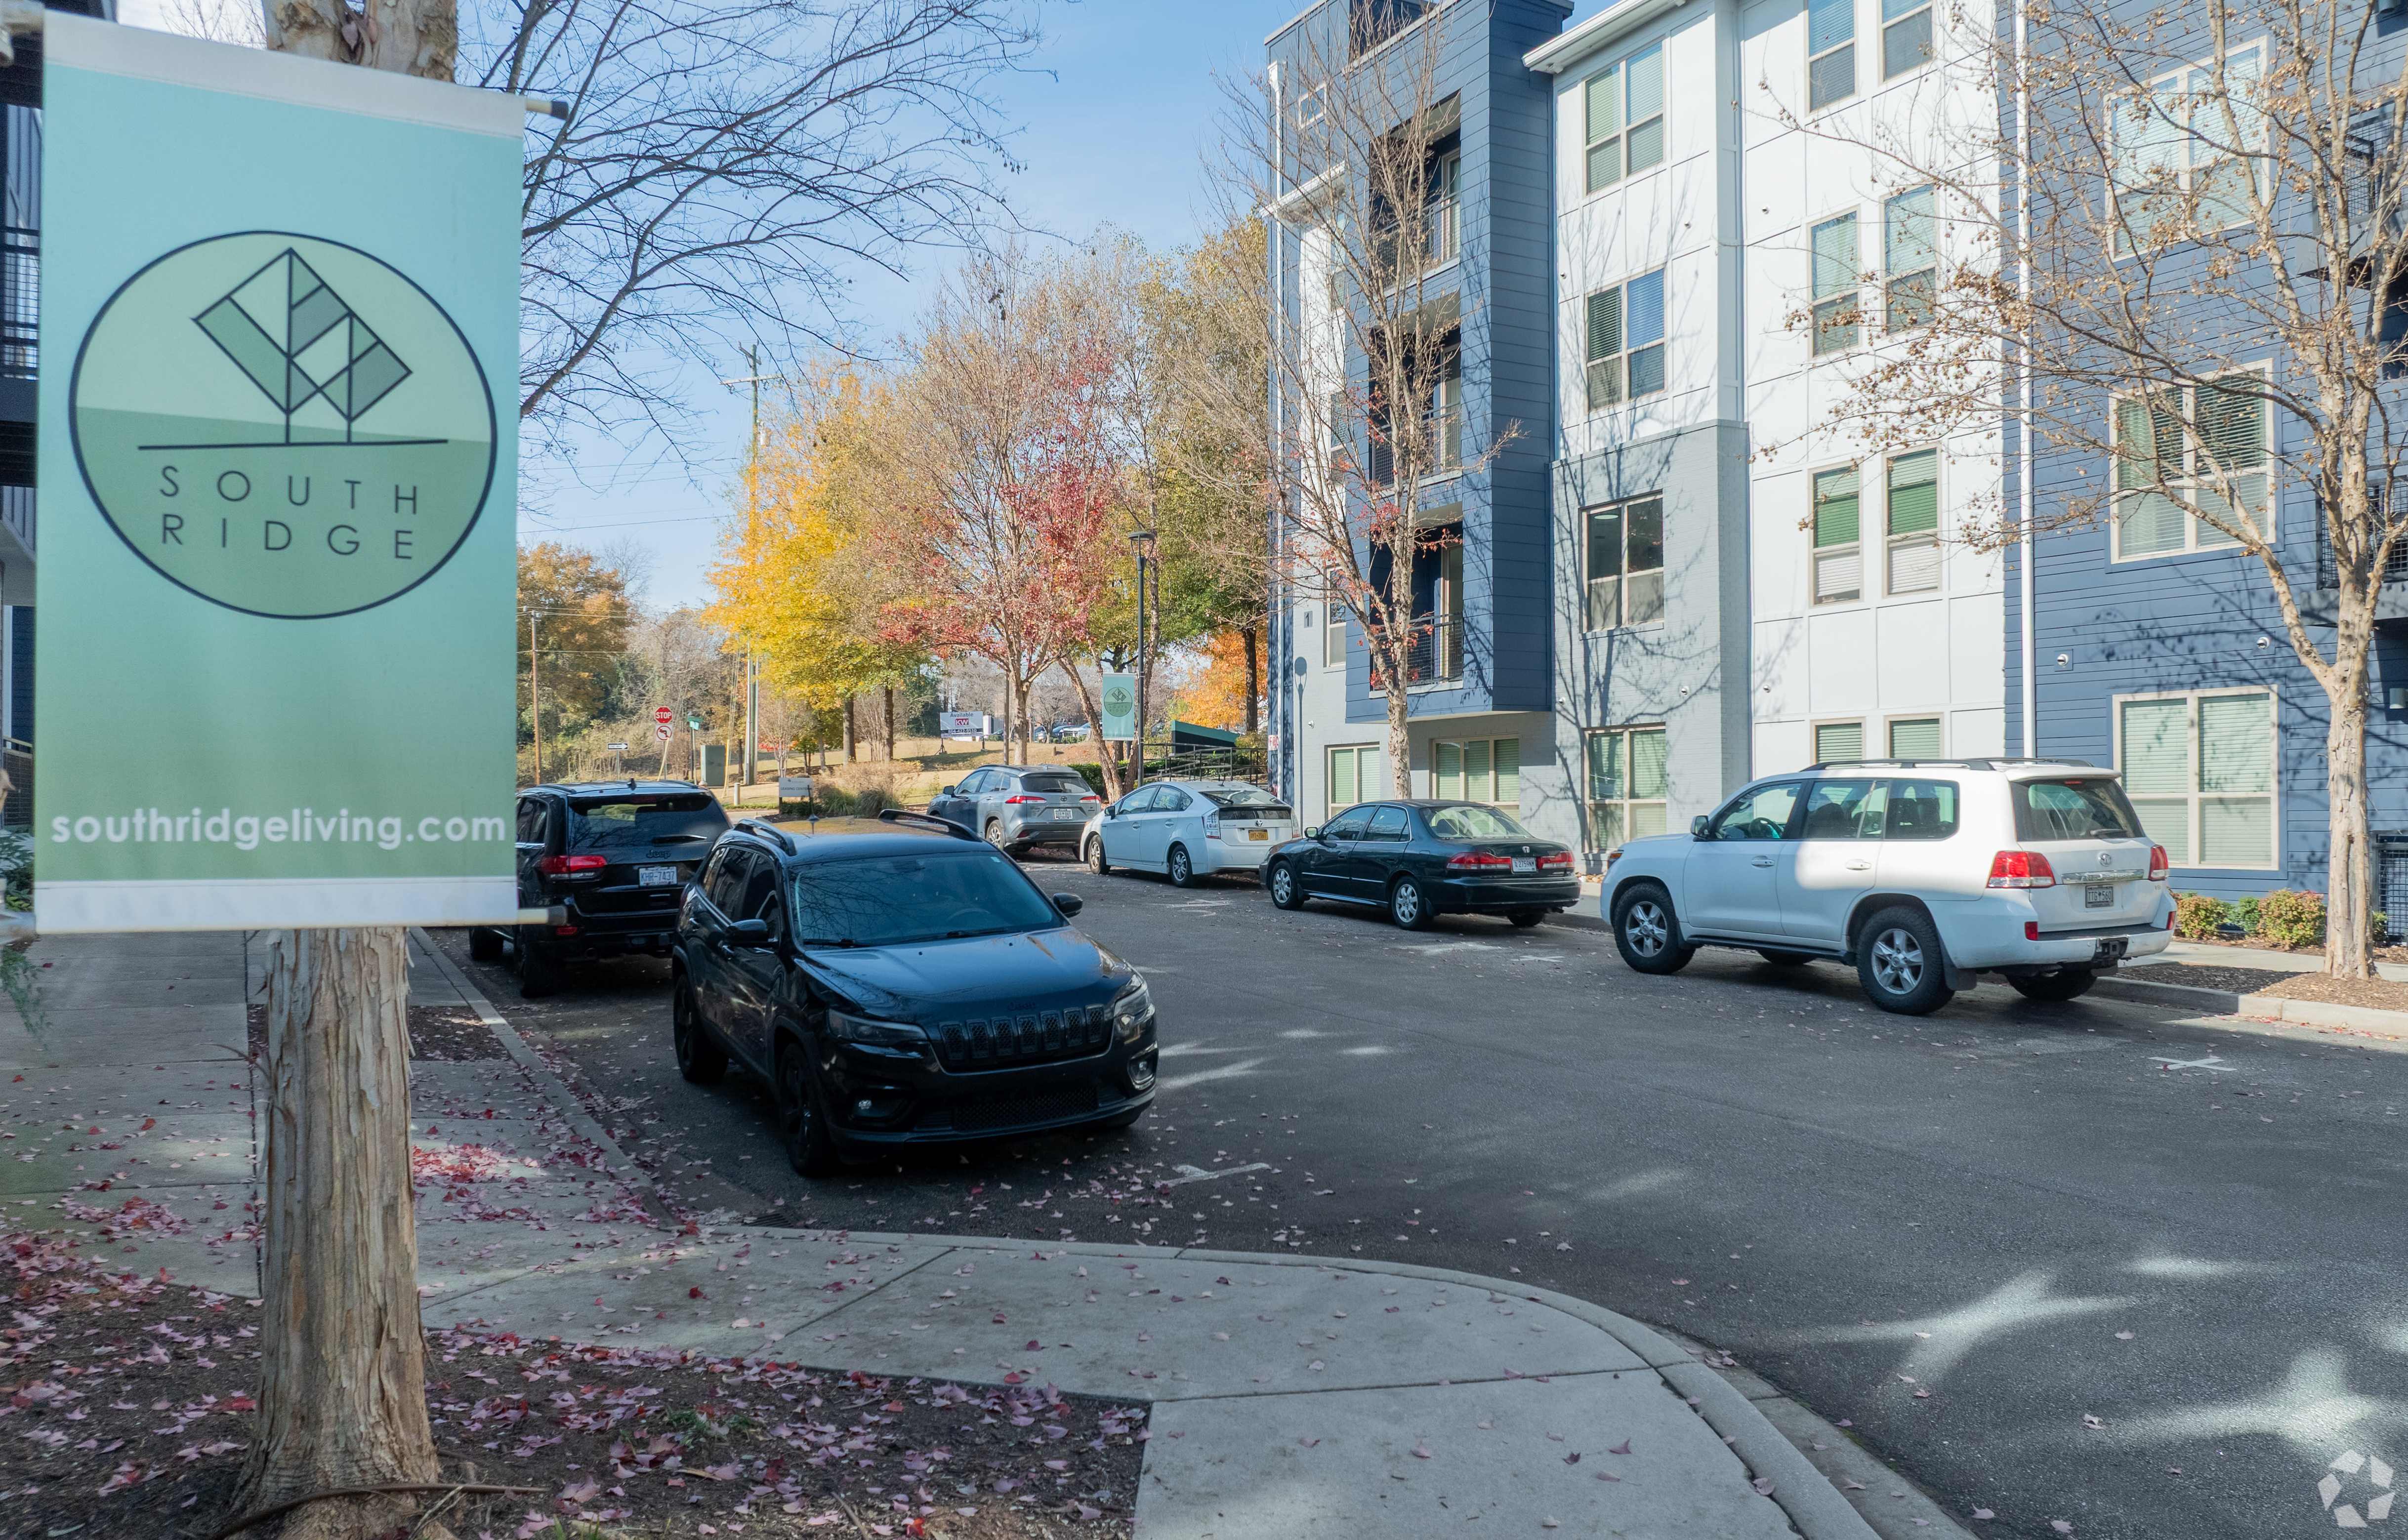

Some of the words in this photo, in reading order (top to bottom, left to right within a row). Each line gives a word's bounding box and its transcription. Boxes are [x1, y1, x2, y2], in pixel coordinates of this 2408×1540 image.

[160, 465, 416, 515] SOUTH
[162, 513, 414, 560] RIDGE
[1305, 612, 1309, 627] 1
[50, 807, 505, 851] southridgeliving.com
[646, 850, 671, 859] Jeep
